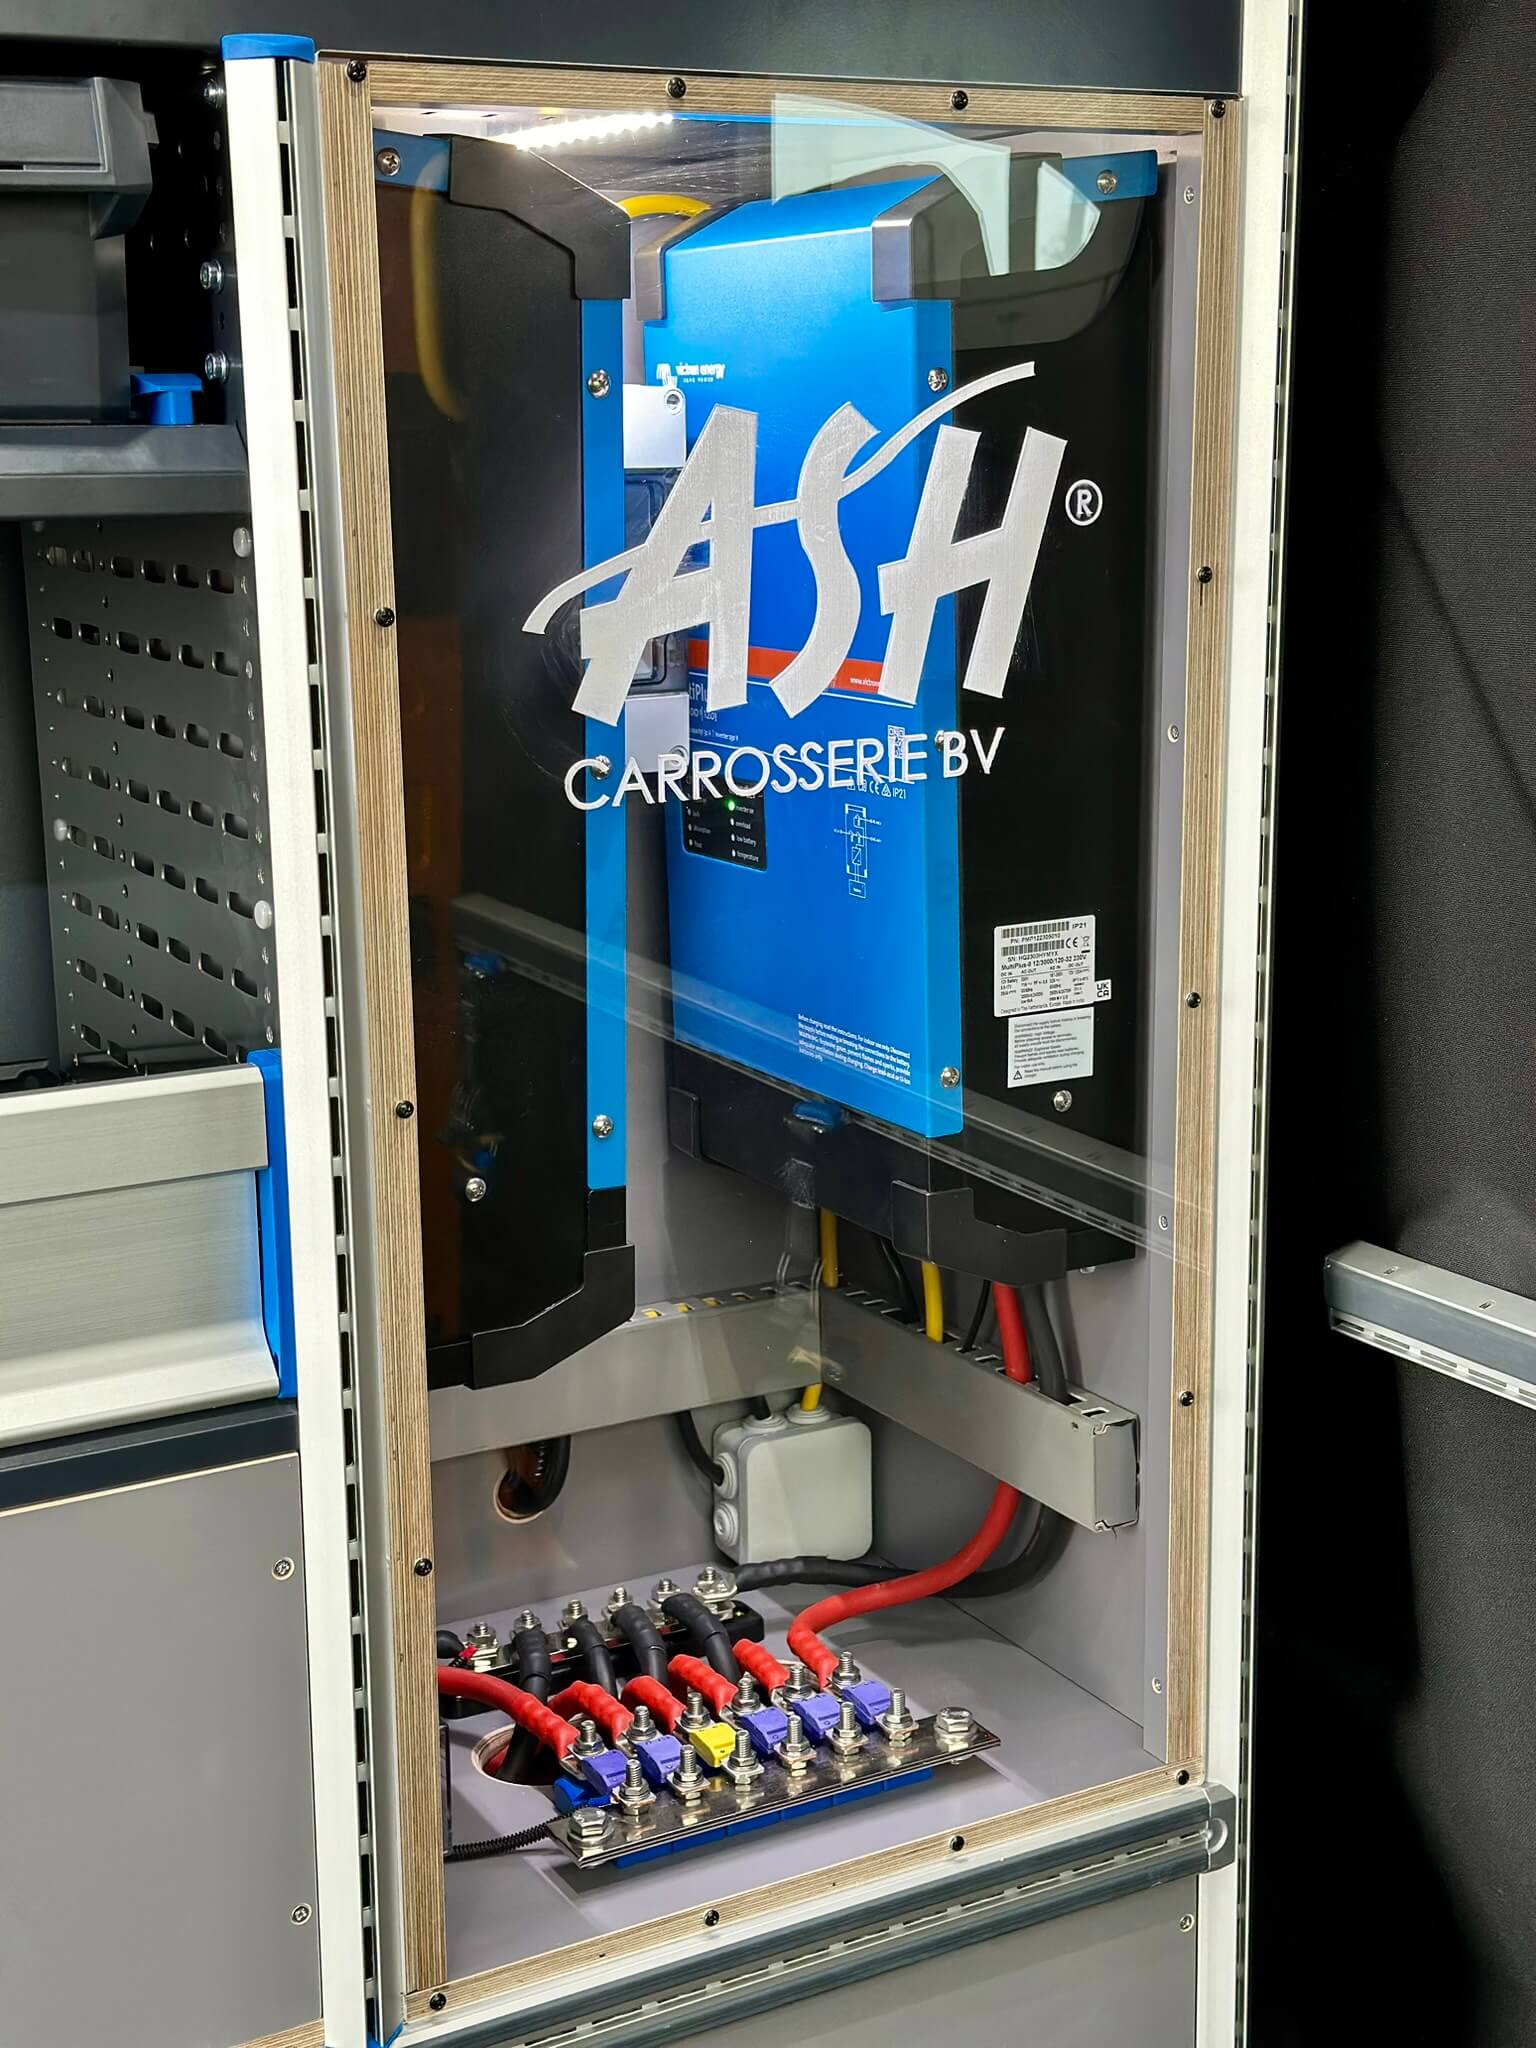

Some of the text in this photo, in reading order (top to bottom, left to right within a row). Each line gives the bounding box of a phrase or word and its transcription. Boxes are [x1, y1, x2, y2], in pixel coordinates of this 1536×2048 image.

[521, 361, 1068, 728] ASH
[564, 726, 1007, 811] CARROSSERIE BV
[892, 787, 907, 800] IP21
[1072, 922, 1087, 930] IP21
